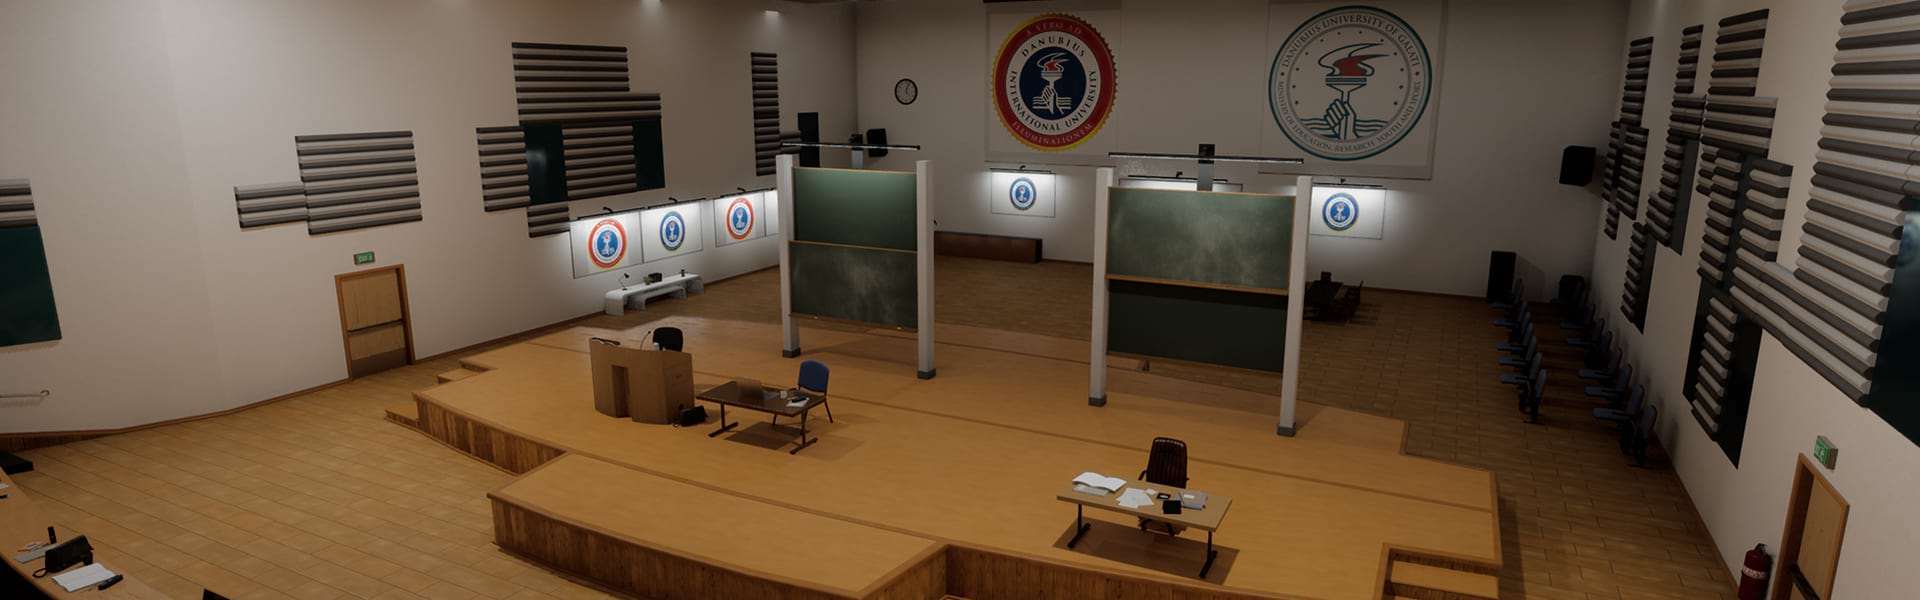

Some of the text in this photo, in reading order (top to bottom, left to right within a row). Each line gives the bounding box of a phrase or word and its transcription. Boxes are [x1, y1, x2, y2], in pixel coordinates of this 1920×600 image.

[1021, 36, 1086, 57] DANUBIUS
[1282, 14, 1421, 68] DANUBIUS UNIVERSITY OF GALATI
[1010, 70, 1097, 131] INTERNATIONAL UNIVERSITY
[1376, 119, 1402, 143] YOUTH
[1400, 106, 1414, 123] AND
[1412, 81, 1422, 105] SPORT
[1012, 121, 1094, 146] ILLUMINATIONEM
